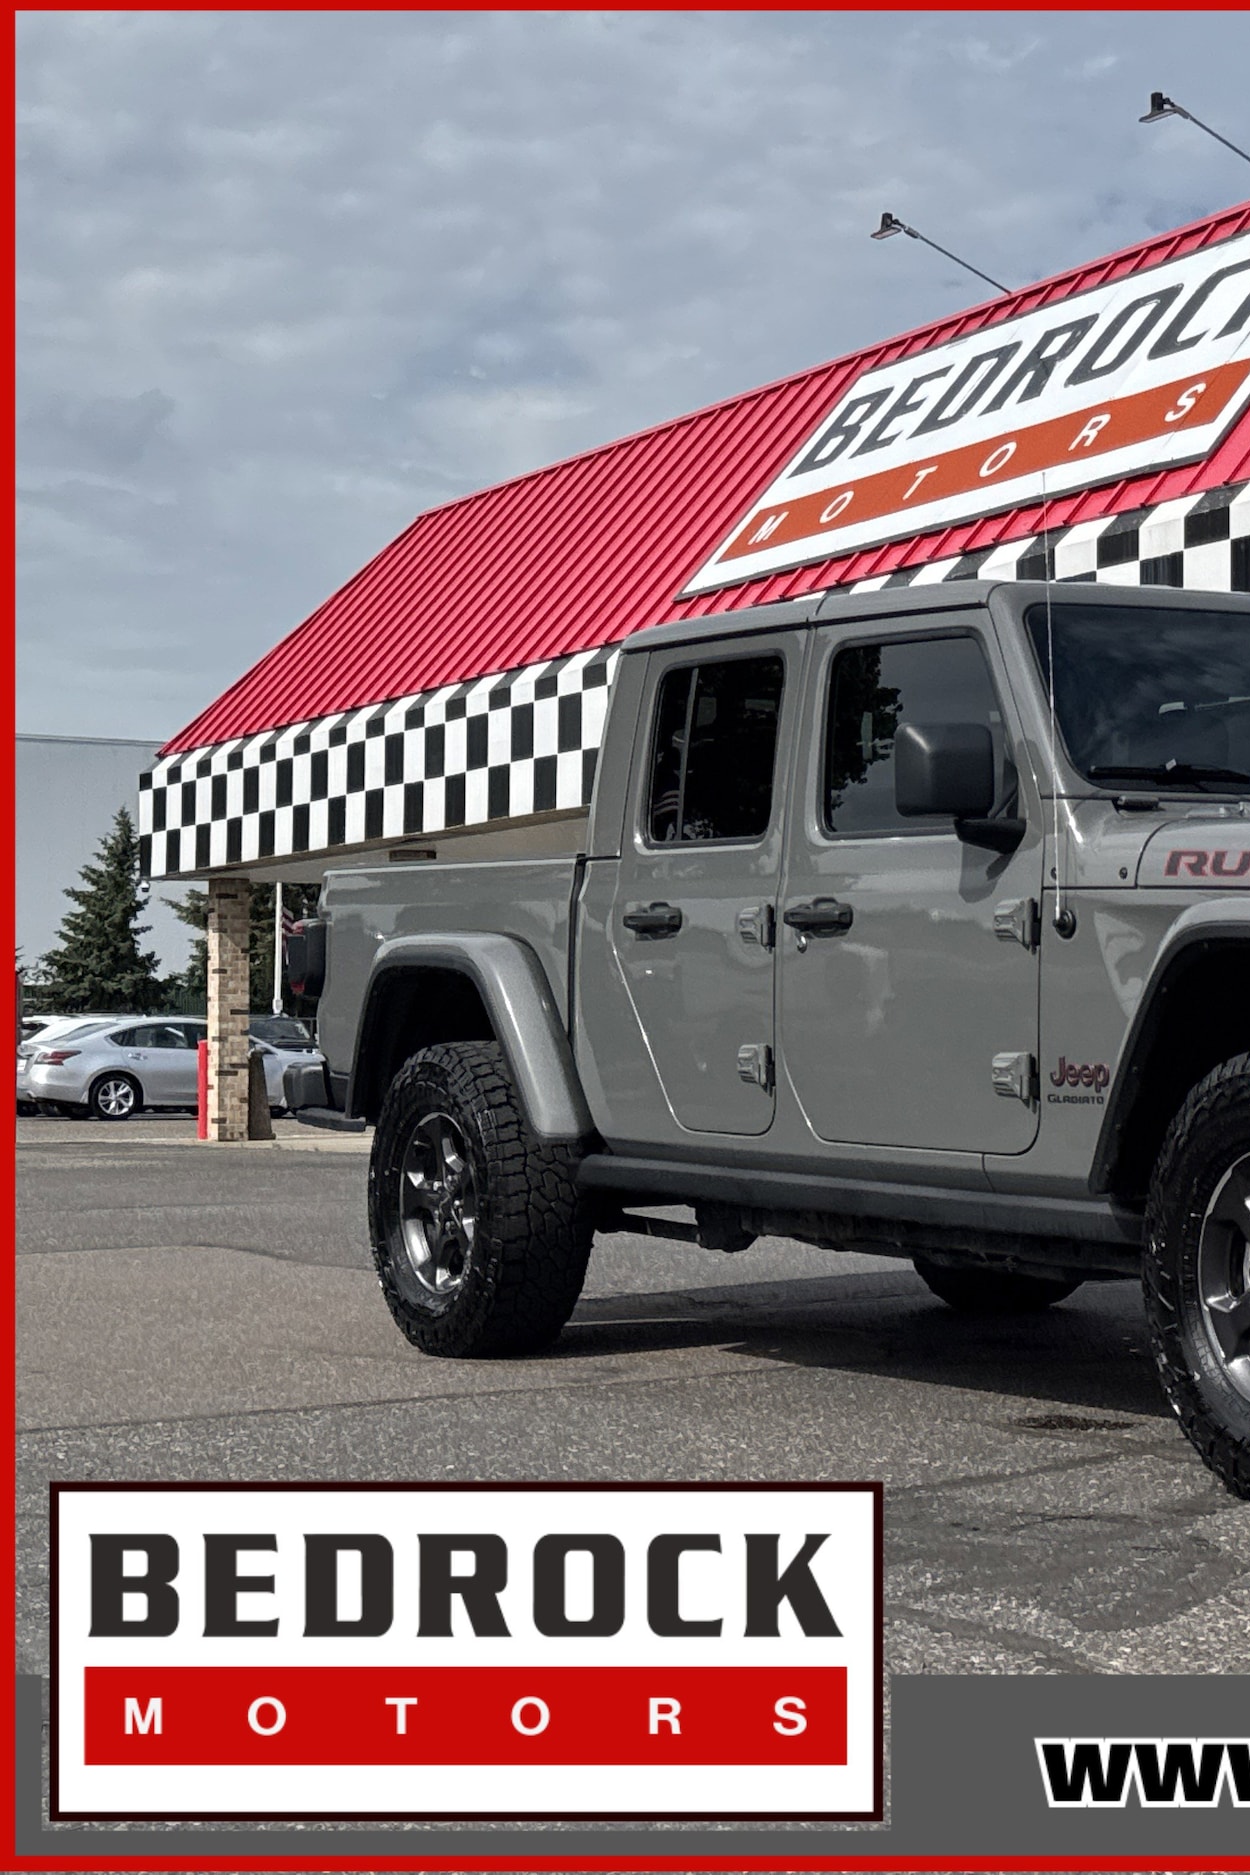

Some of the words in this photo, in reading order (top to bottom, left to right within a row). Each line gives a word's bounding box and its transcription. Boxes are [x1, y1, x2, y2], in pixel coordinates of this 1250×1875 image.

[749, 381, 1206, 544] MOTORS
[1050, 1056, 1110, 1093] Jeep
[1047, 1094, 1105, 1104] GLADIATO
